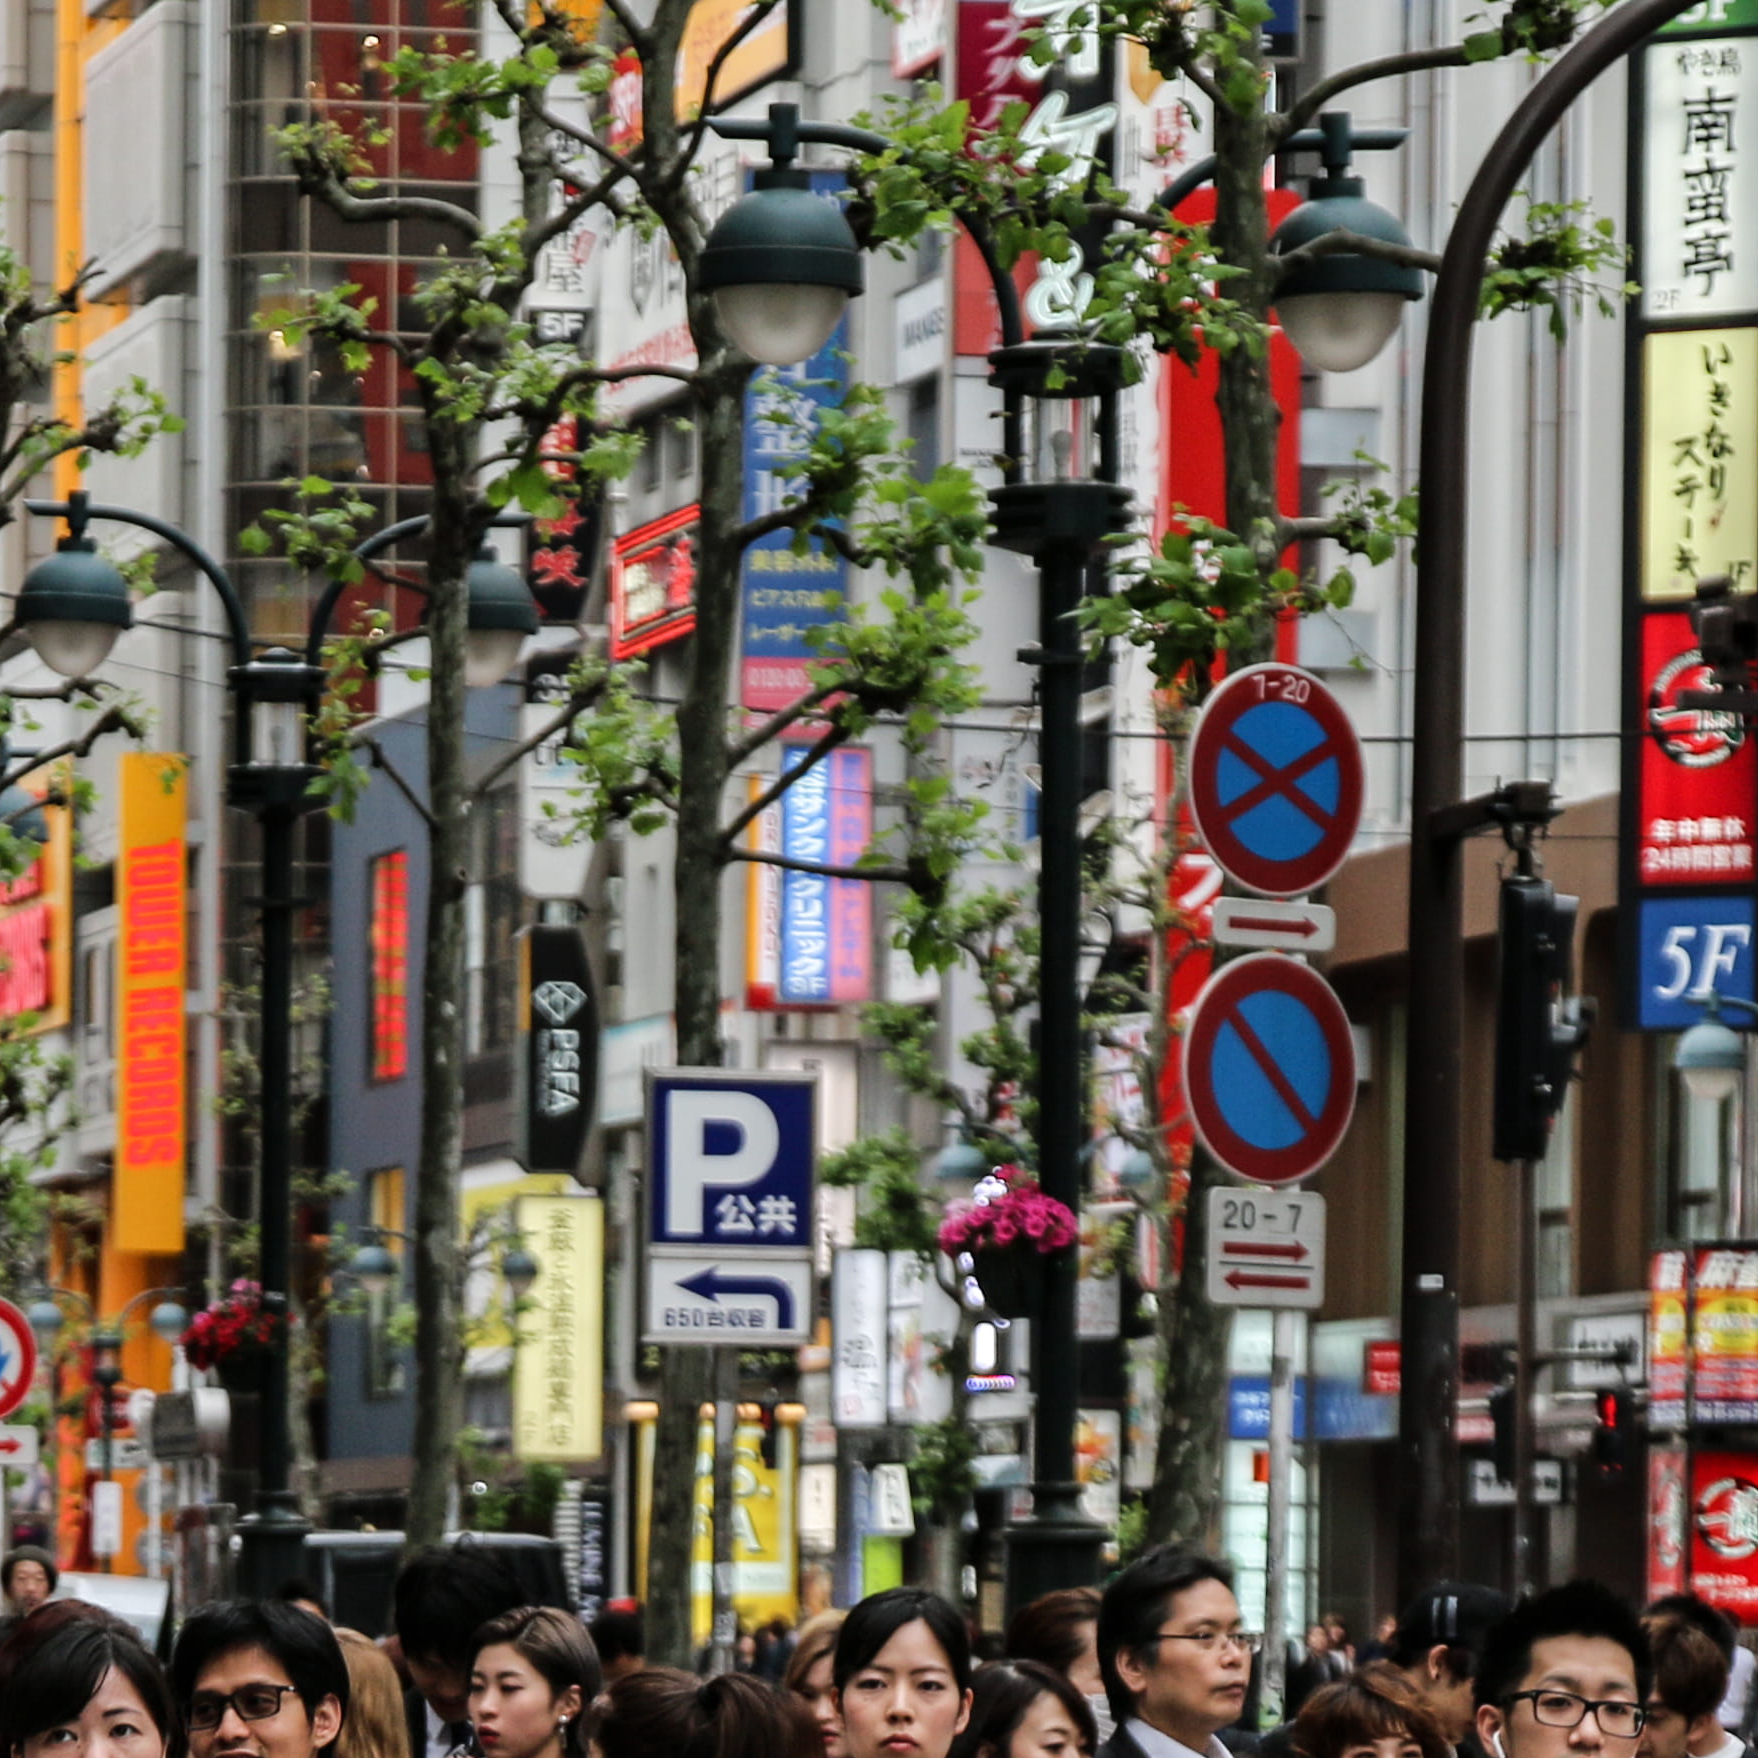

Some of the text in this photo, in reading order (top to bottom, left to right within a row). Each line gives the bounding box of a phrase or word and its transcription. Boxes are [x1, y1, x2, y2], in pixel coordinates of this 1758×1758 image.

[1701, 343, 1734, 501] いきなり
[1673, 436, 1705, 579] ステーキ
[1250, 673, 1311, 704] 7-20
[126, 838, 183, 1169] TOWER RECORDS
[1656, 924, 1752, 1001] 5F
[666, 1090, 780, 1236] P
[715, 1194, 798, 1236] 公共
